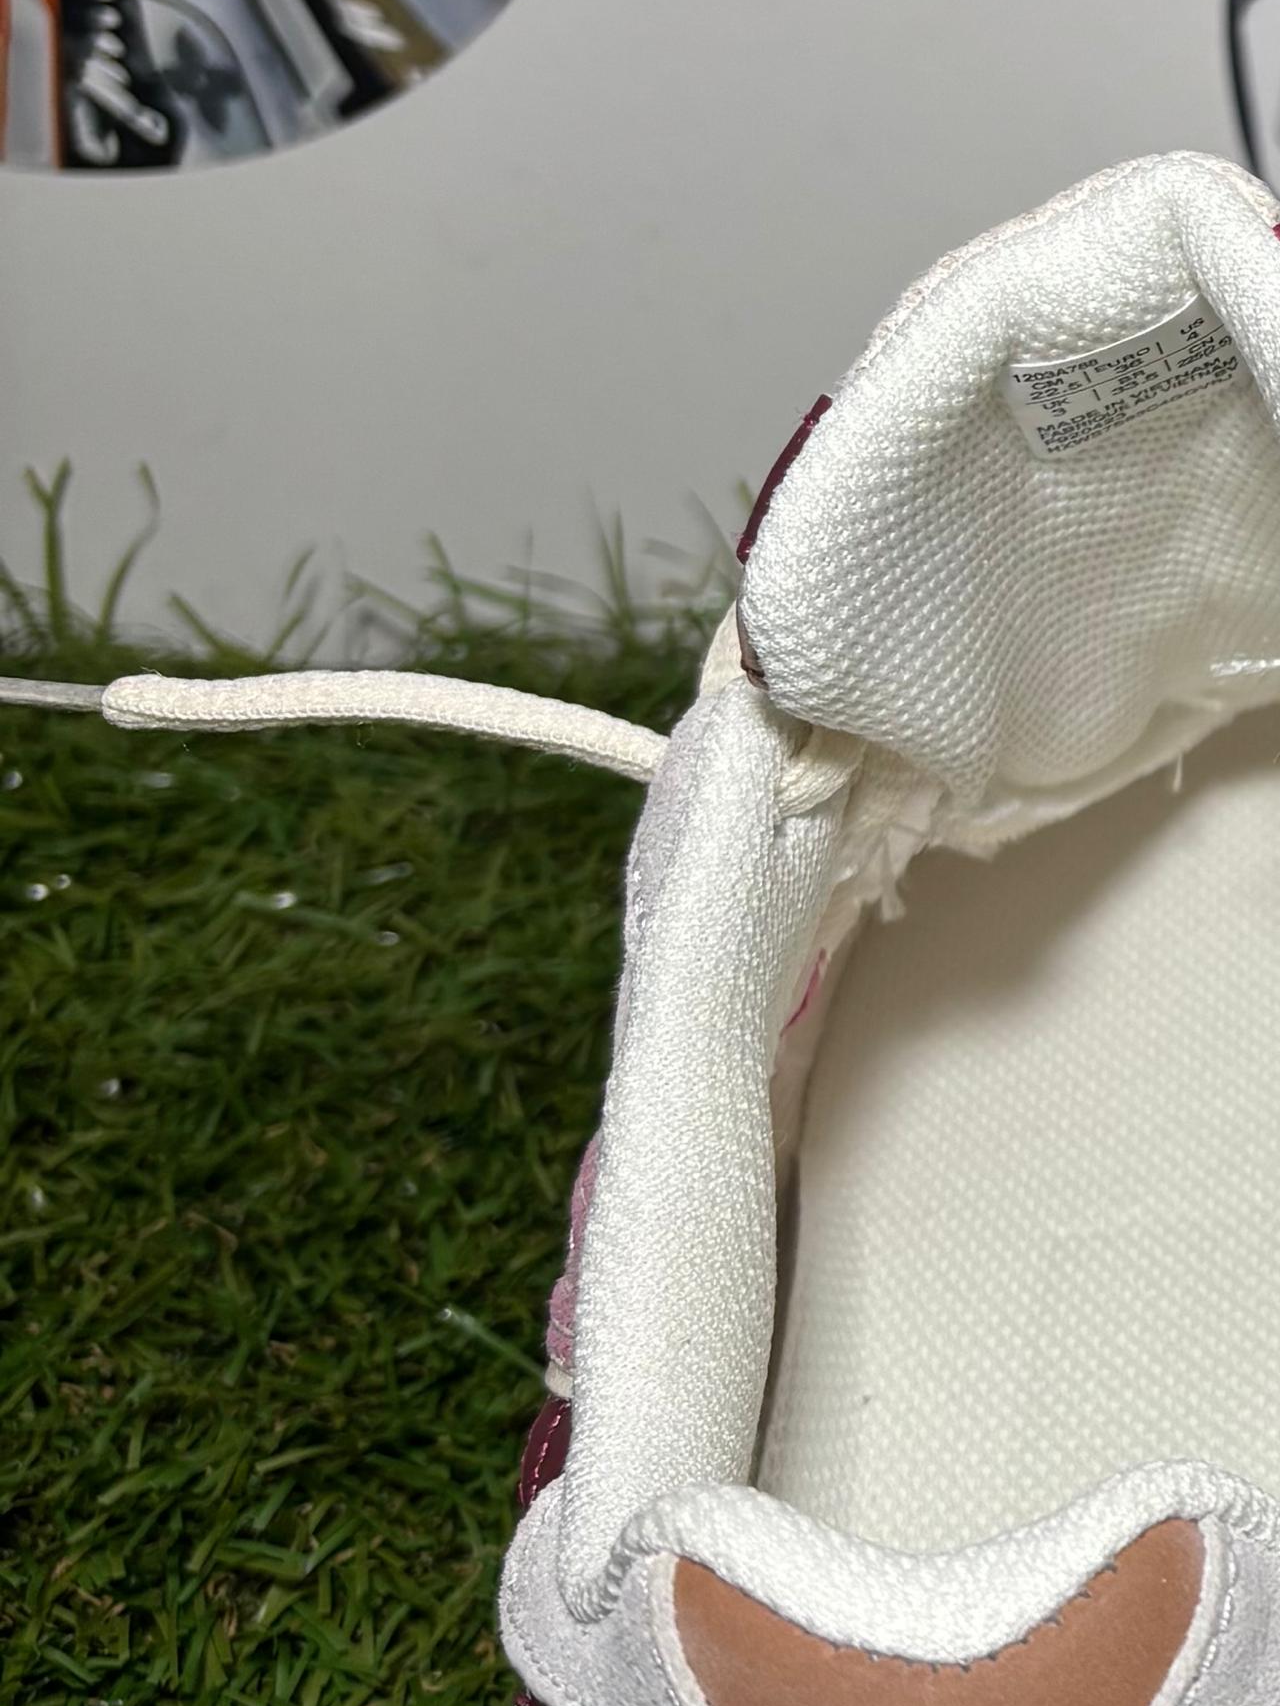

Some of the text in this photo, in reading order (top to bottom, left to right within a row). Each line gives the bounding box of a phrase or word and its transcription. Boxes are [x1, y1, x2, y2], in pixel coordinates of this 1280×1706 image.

[1029, 331, 1199, 400] 22.5 36 4
[1031, 317, 1205, 390] CM EURO US
[1042, 336, 1215, 410] UK BR CN
[1159, 355, 1237, 393] VIETNAM
[1036, 356, 1221, 435] MADE IN VIETNAM
[1051, 407, 1067, 418] 3
[1111, 371, 1160, 396] 33.5
